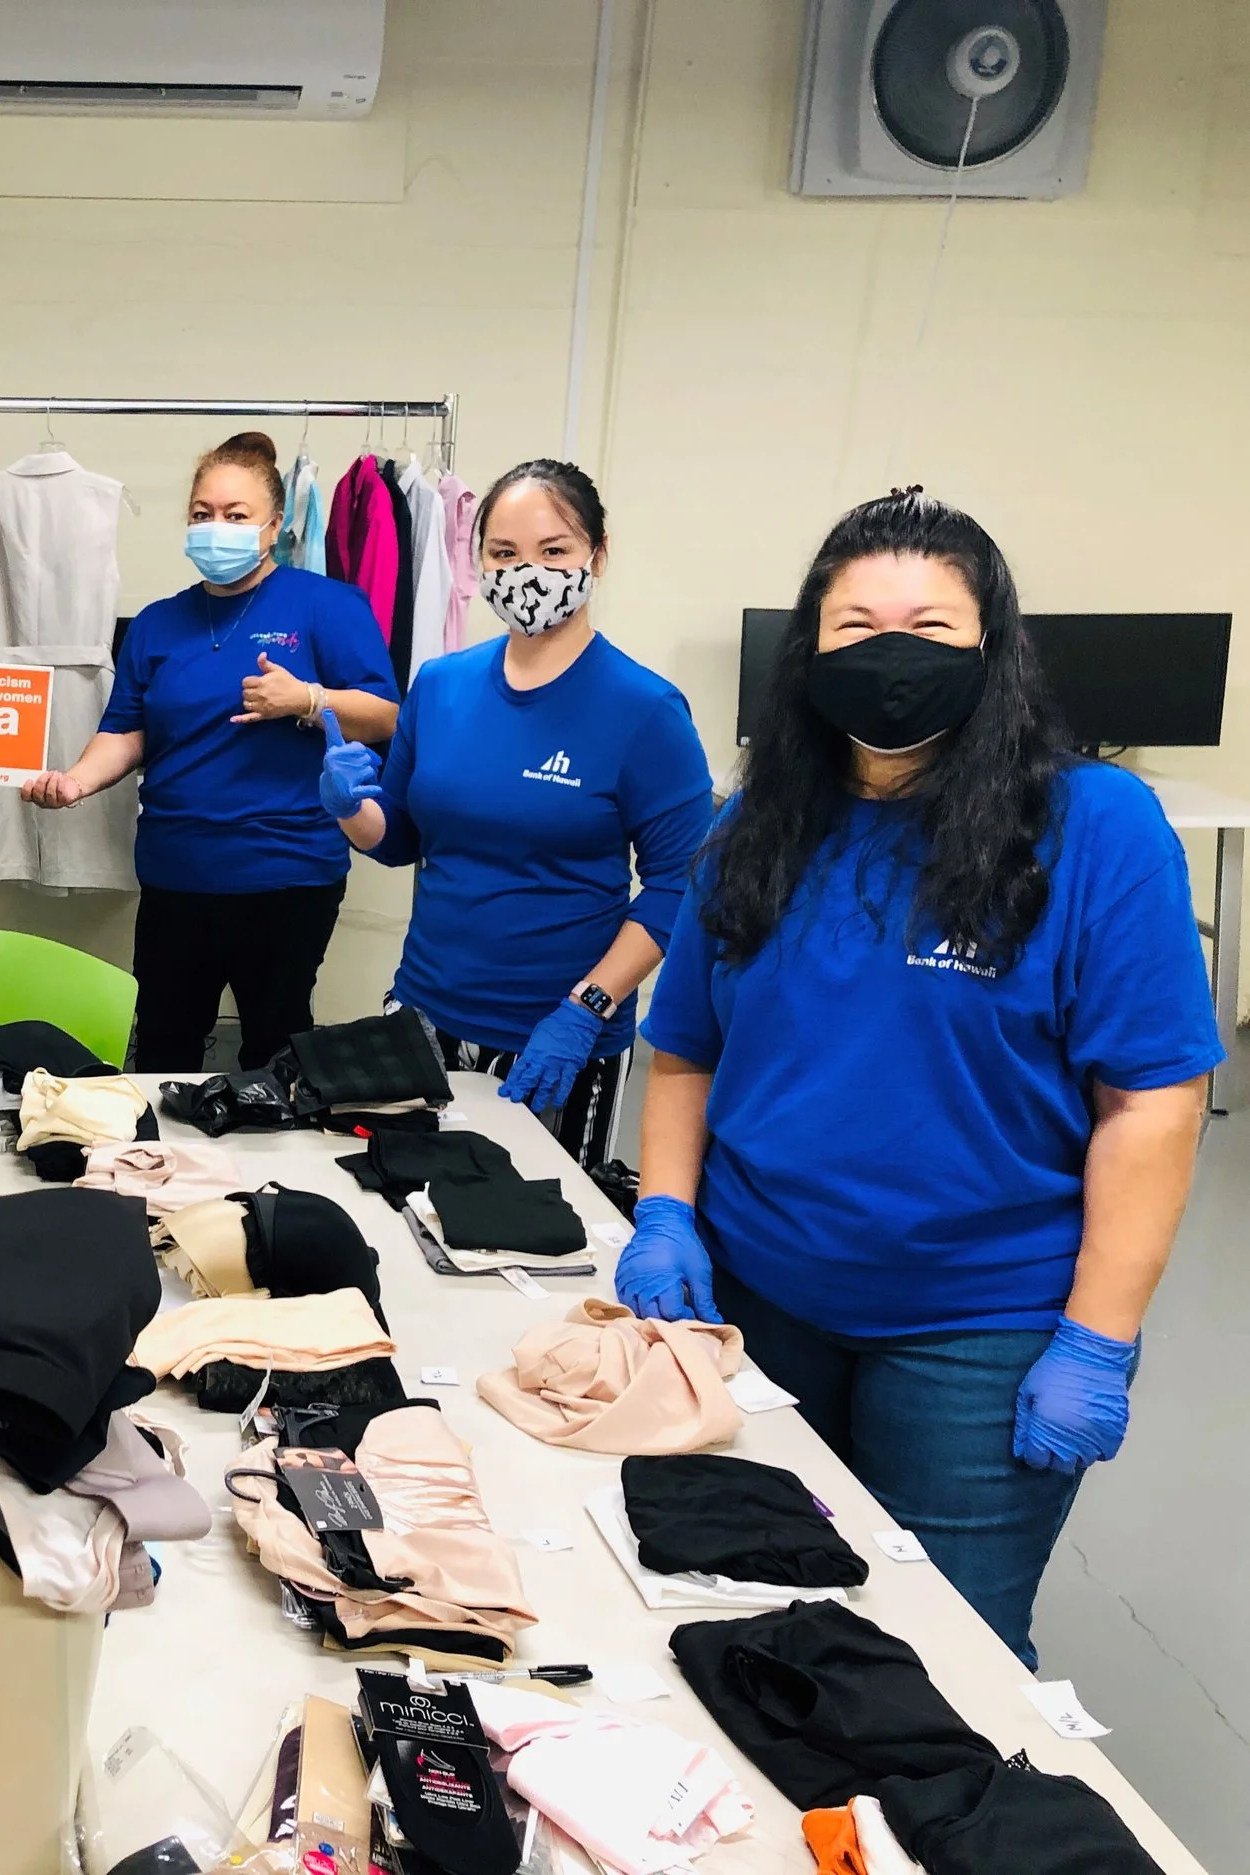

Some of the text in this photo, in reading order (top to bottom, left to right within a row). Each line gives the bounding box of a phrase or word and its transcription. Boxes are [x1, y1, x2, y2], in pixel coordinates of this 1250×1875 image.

[522, 768, 581, 788] Bank of Hawaii
[906, 954, 997, 979] Bank of Hawaii
[379, 1700, 468, 1727] minicci
